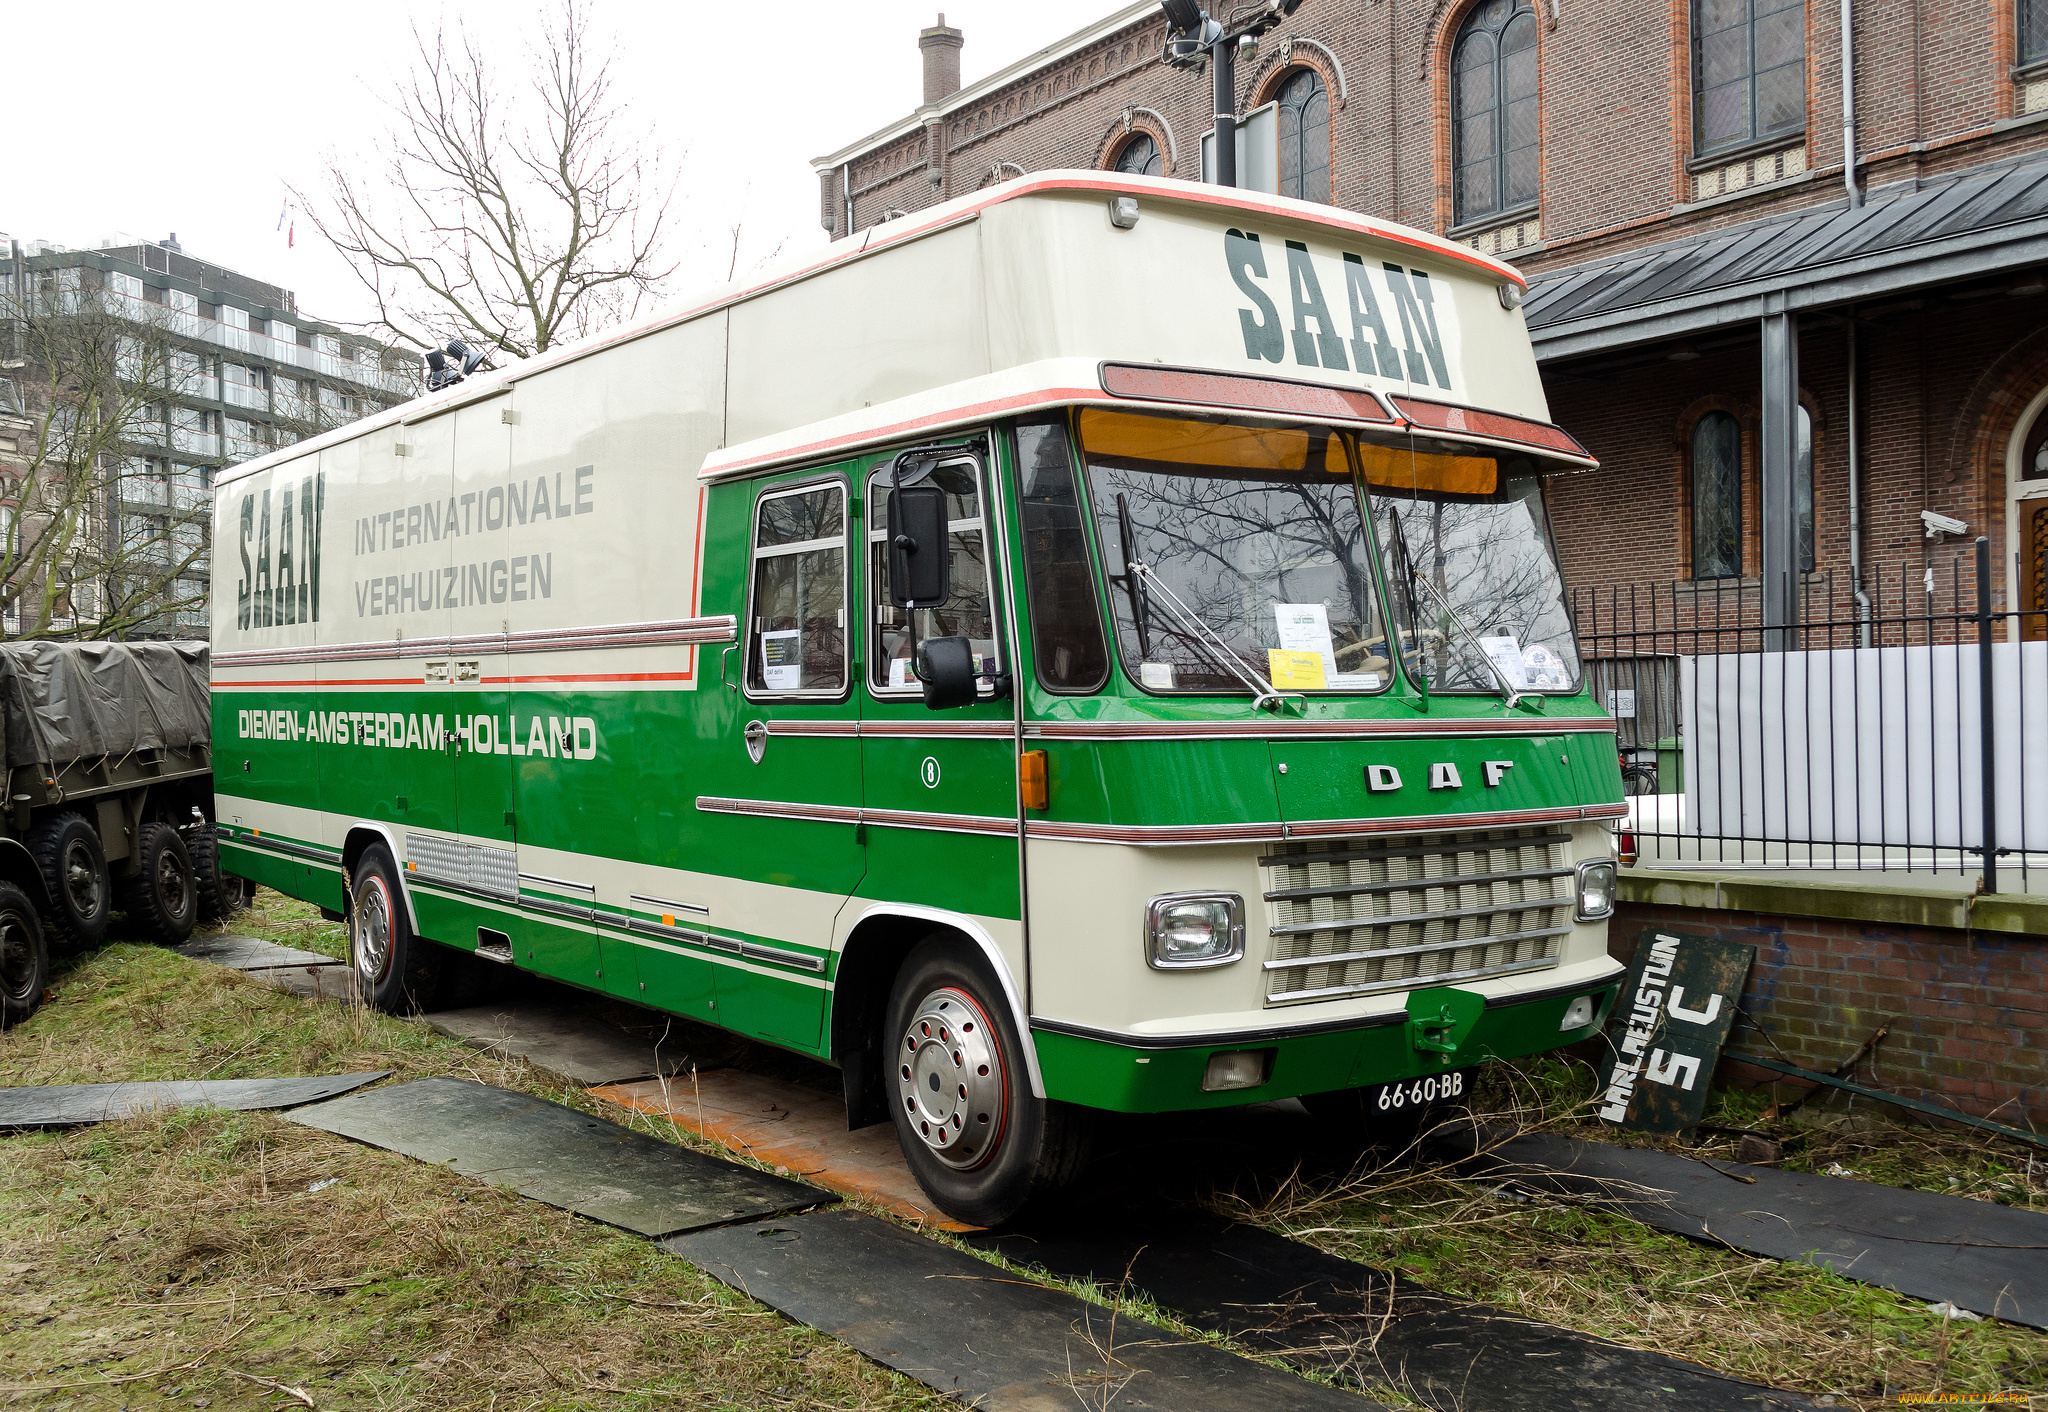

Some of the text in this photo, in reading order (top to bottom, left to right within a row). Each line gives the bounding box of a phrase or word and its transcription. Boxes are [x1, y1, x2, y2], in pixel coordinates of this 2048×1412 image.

[1224, 227, 1452, 391] SAAN
[237, 471, 326, 632] SAAN
[355, 465, 594, 556] INTERNATIONALE
[355, 552, 552, 618] VERHUIZINGEN
[1364, 760, 1514, 793] DAF
